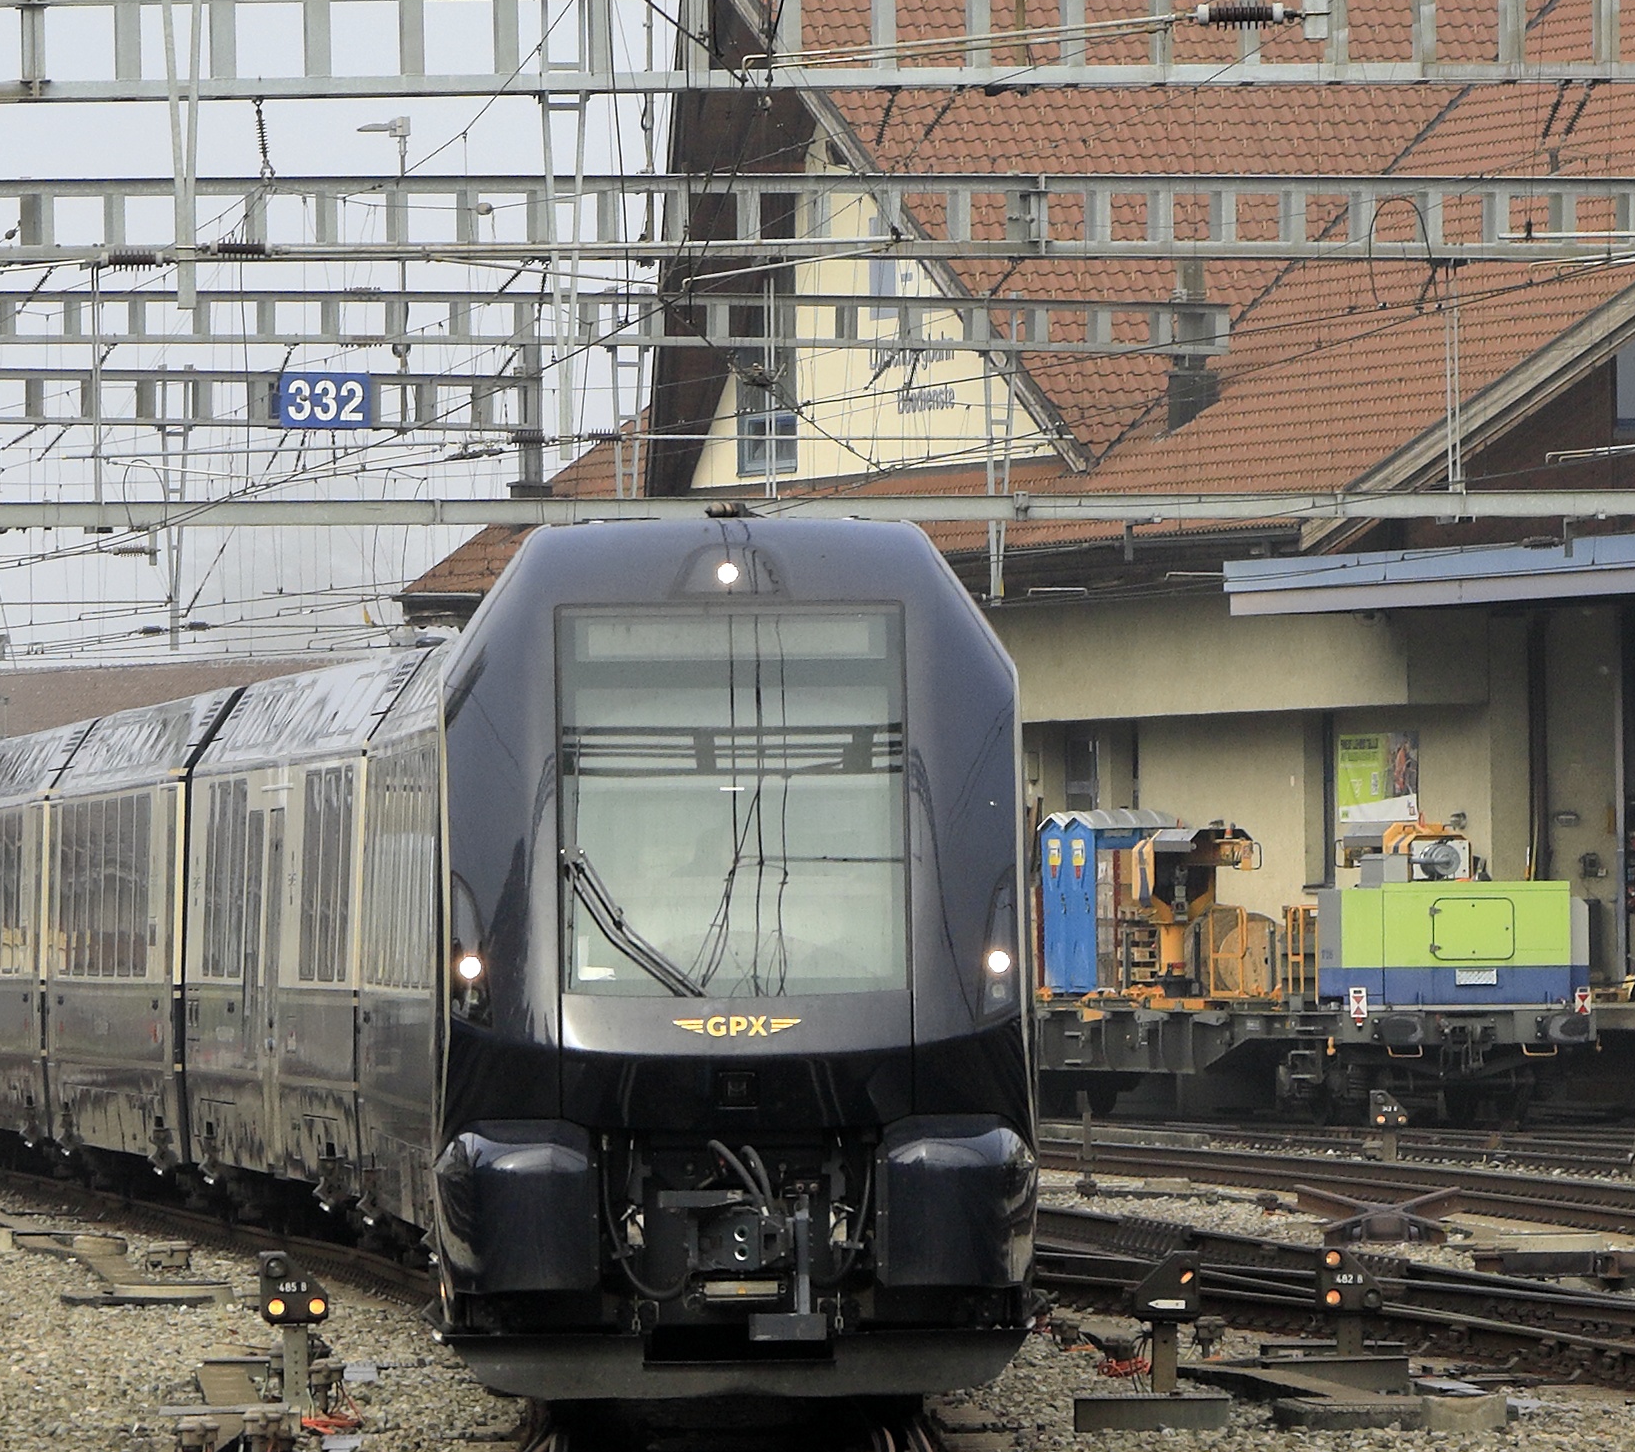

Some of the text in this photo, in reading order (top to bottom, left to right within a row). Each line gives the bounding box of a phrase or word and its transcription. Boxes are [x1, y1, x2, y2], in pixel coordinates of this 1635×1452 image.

[287, 379, 366, 422] 332
[706, 1015, 768, 1038] GPX
[278, 1282, 298, 1293] 485
[1335, 1274, 1354, 1285] 482
